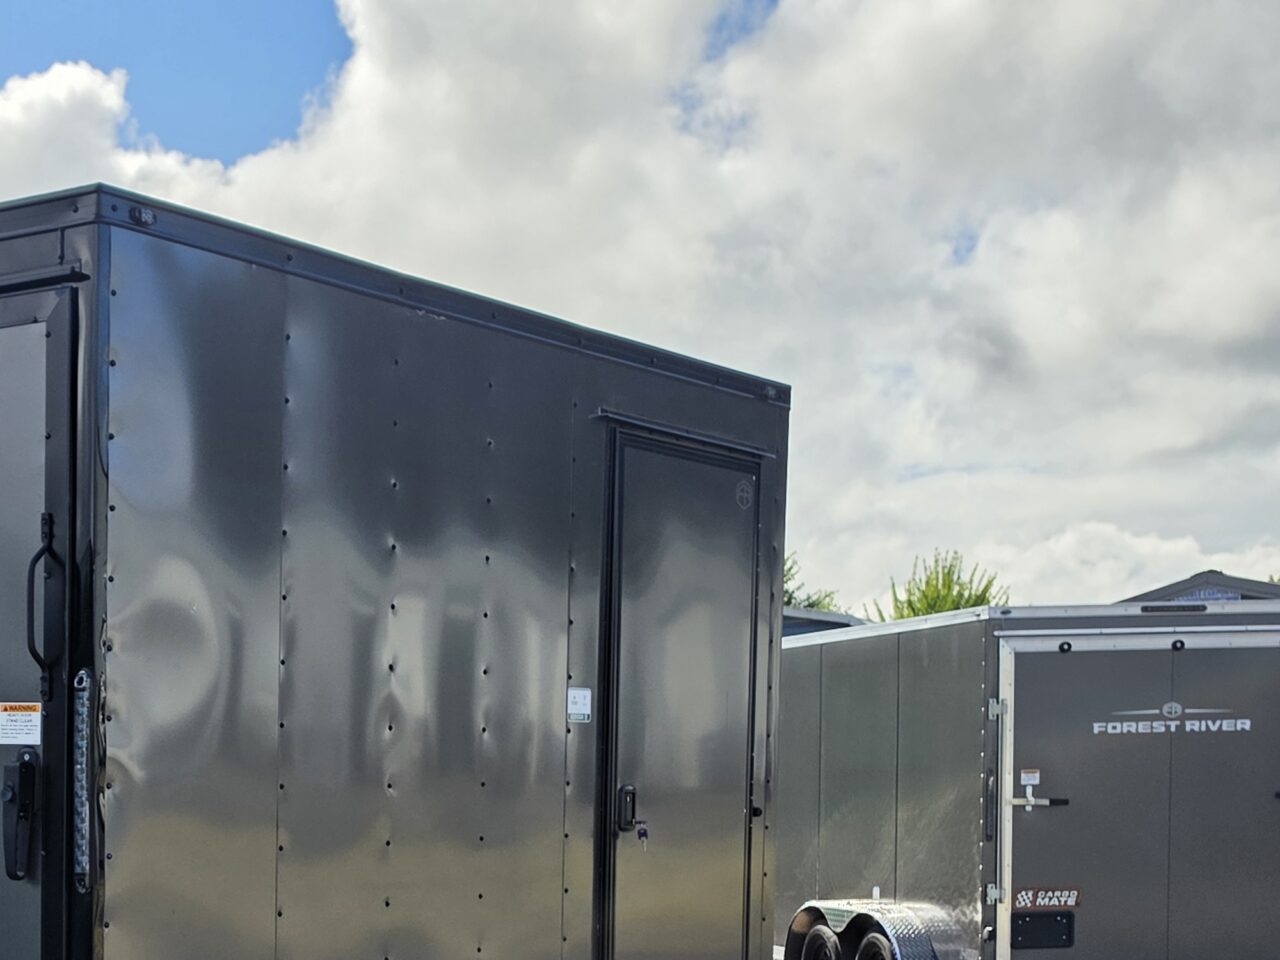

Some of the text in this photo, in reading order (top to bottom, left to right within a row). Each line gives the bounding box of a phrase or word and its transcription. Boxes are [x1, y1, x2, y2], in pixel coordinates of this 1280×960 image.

[1092, 718, 1252, 735] FOREST RIVER
[1035, 897, 1078, 906] MATE
